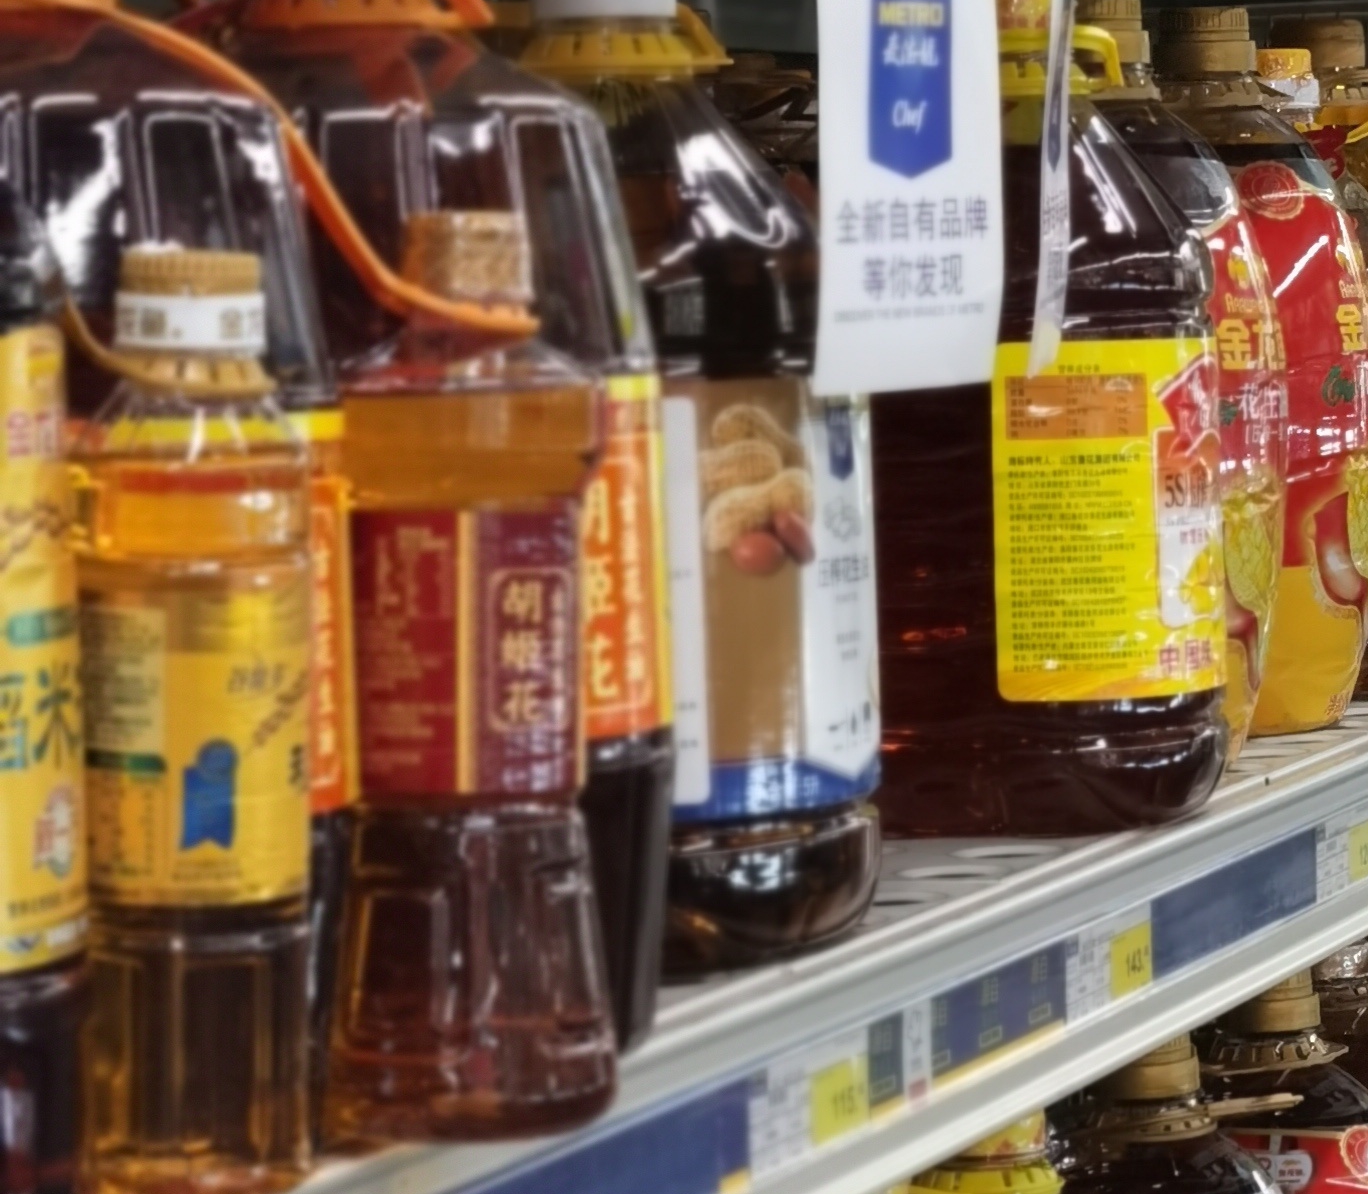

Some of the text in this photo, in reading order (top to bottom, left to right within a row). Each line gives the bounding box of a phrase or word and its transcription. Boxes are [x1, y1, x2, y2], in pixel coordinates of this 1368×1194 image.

[835, 195, 989, 245] 全新自有品牌
[862, 253, 964, 302] 等你发现
